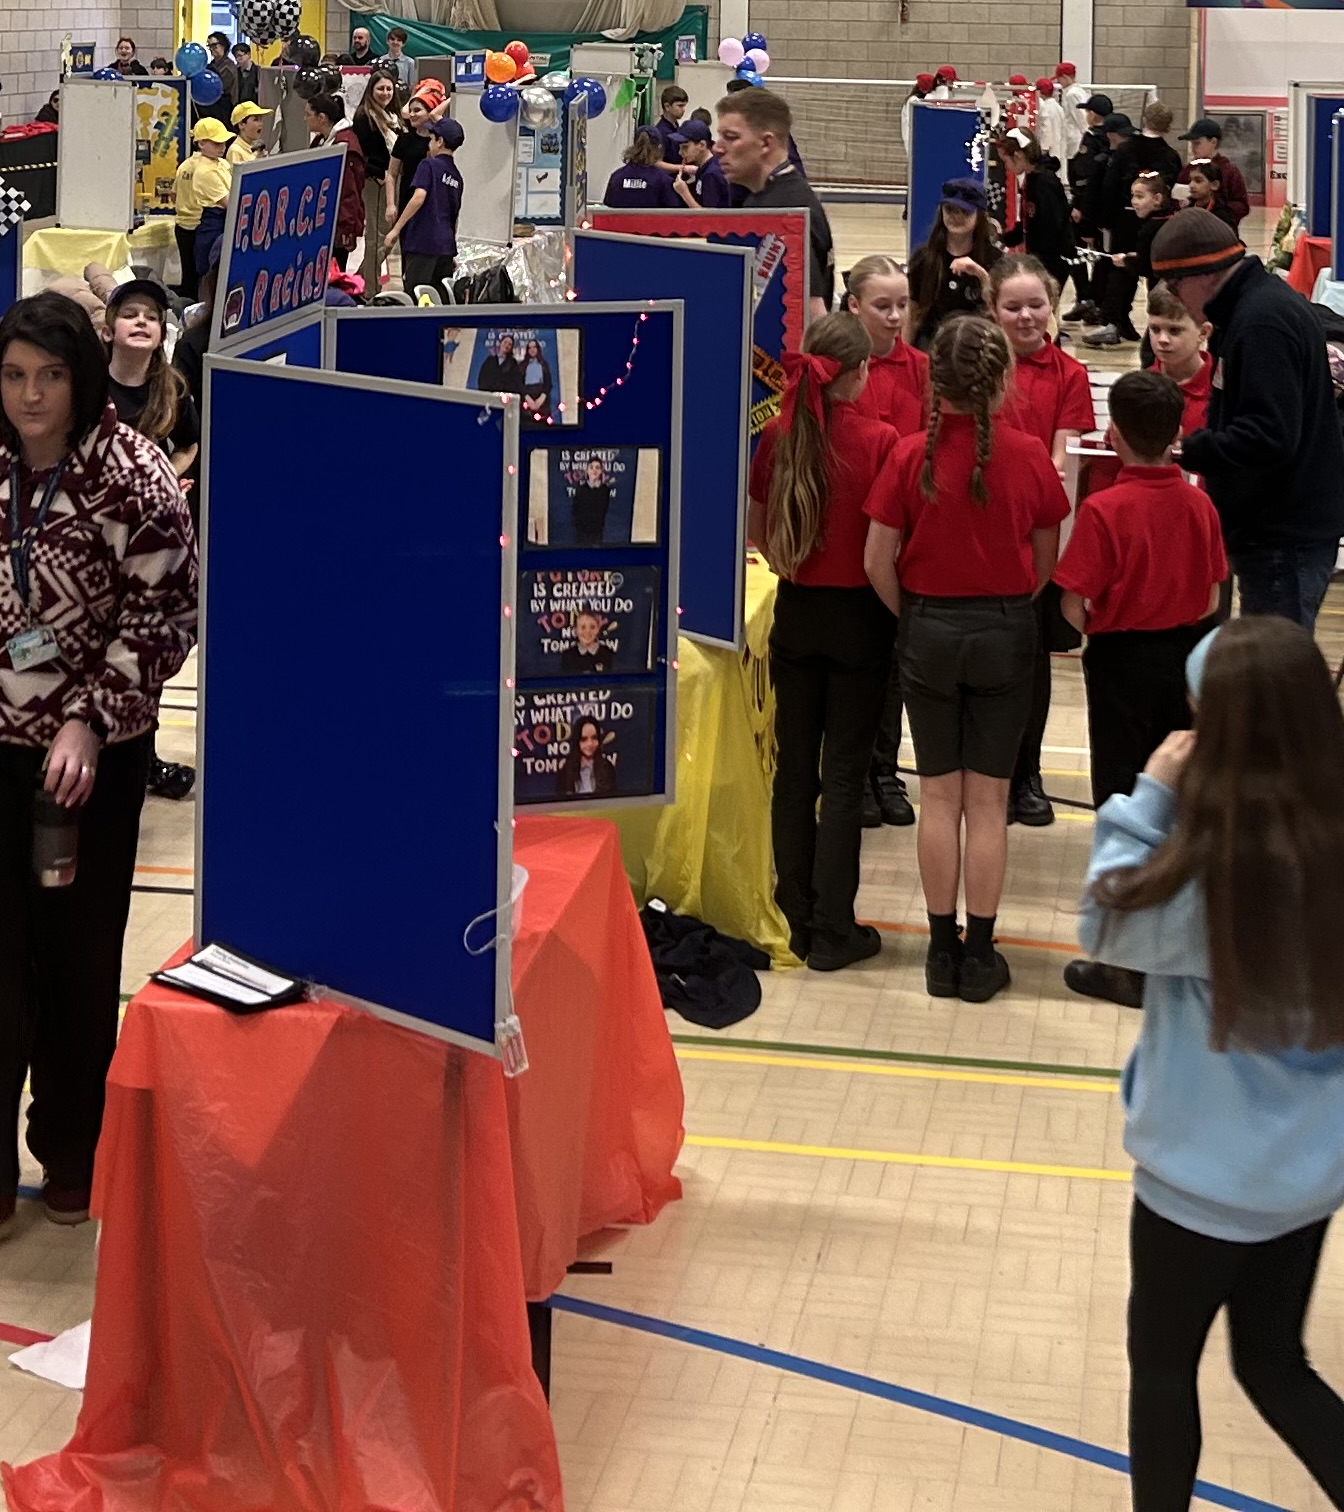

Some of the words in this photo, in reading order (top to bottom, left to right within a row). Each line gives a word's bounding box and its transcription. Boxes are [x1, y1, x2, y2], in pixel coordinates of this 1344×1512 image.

[250, 245, 328, 324] Racing
[533, 582, 547, 598] IS
[552, 580, 615, 598] CREATED
[530, 599, 546, 613] BY
[550, 599, 583, 612] WHAT
[588, 598, 611, 612] YOU
[614, 598, 634, 613] DO
[531, 706, 575, 725] WHAT
[611, 701, 634, 720] DO
